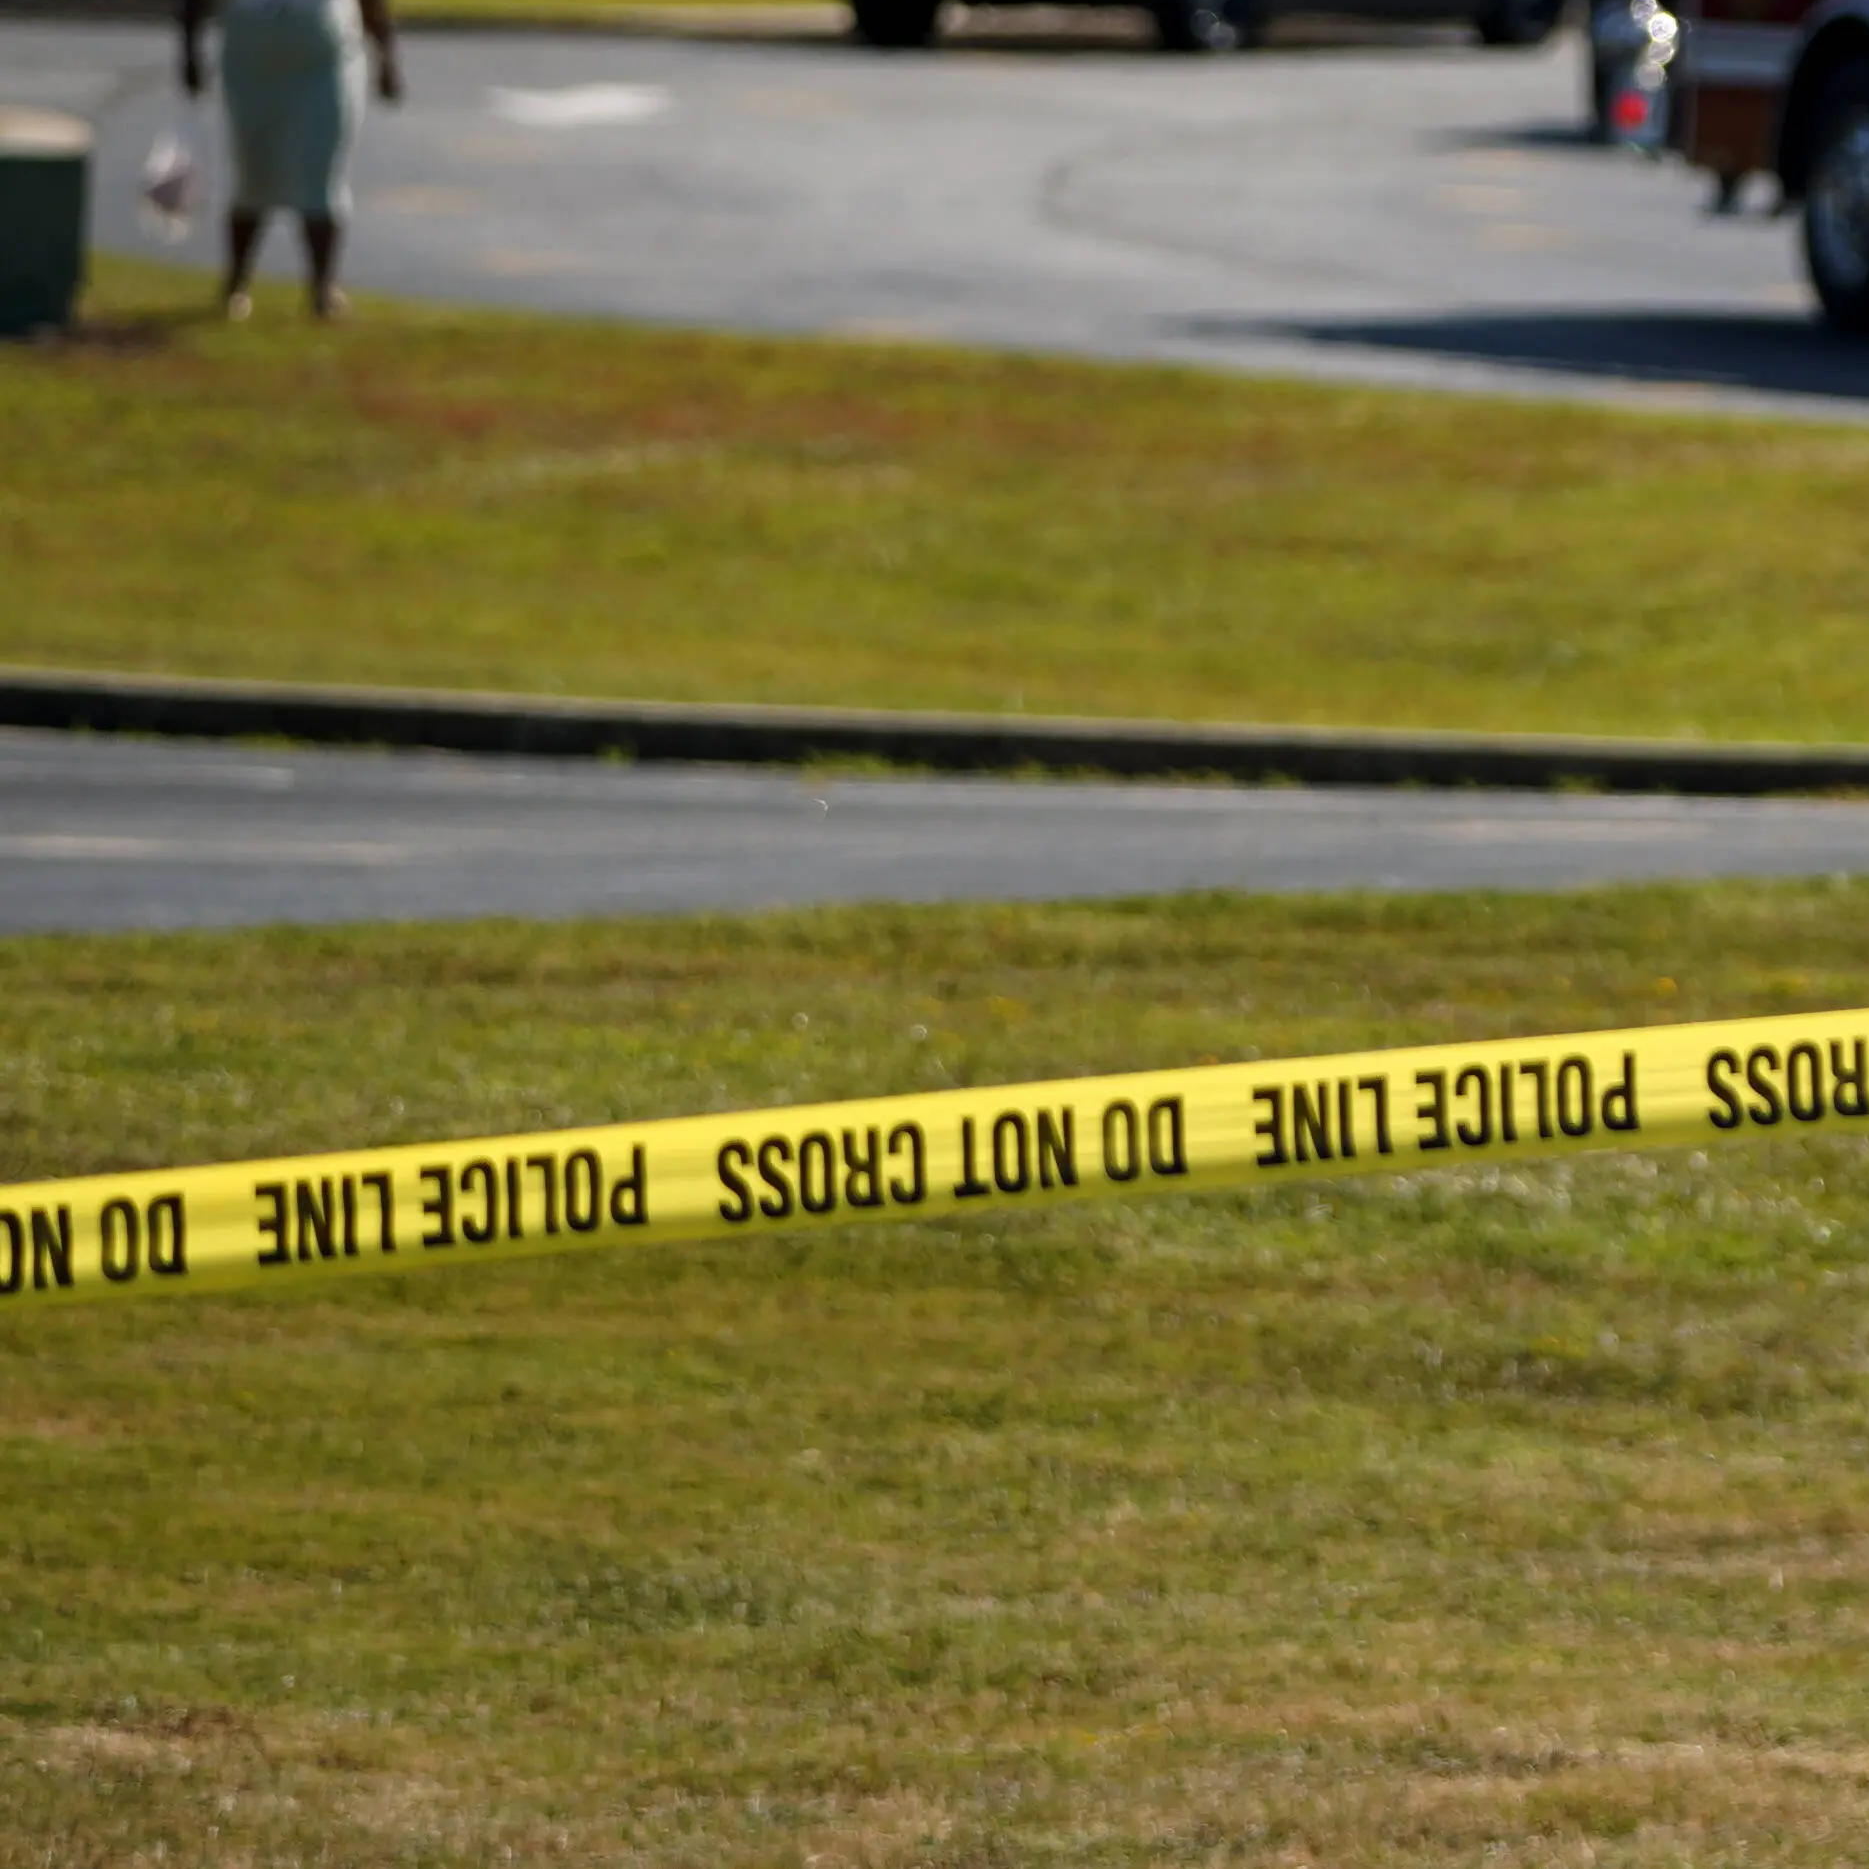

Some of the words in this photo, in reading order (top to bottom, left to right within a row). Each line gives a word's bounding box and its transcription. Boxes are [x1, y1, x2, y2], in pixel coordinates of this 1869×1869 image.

[1102, 1097, 1191, 1187] DO
[1252, 1078, 1395, 1171] LINE
[1414, 1054, 1642, 1155] POLICE
[419, 1147, 651, 1252] POLICE
[716, 1124, 928, 1228] CROSS
[951, 1109, 1081, 1203] NOT
[0, 1205, 76, 1302] NO
[99, 1194, 190, 1288] DO
[254, 1173, 398, 1271] LINE
